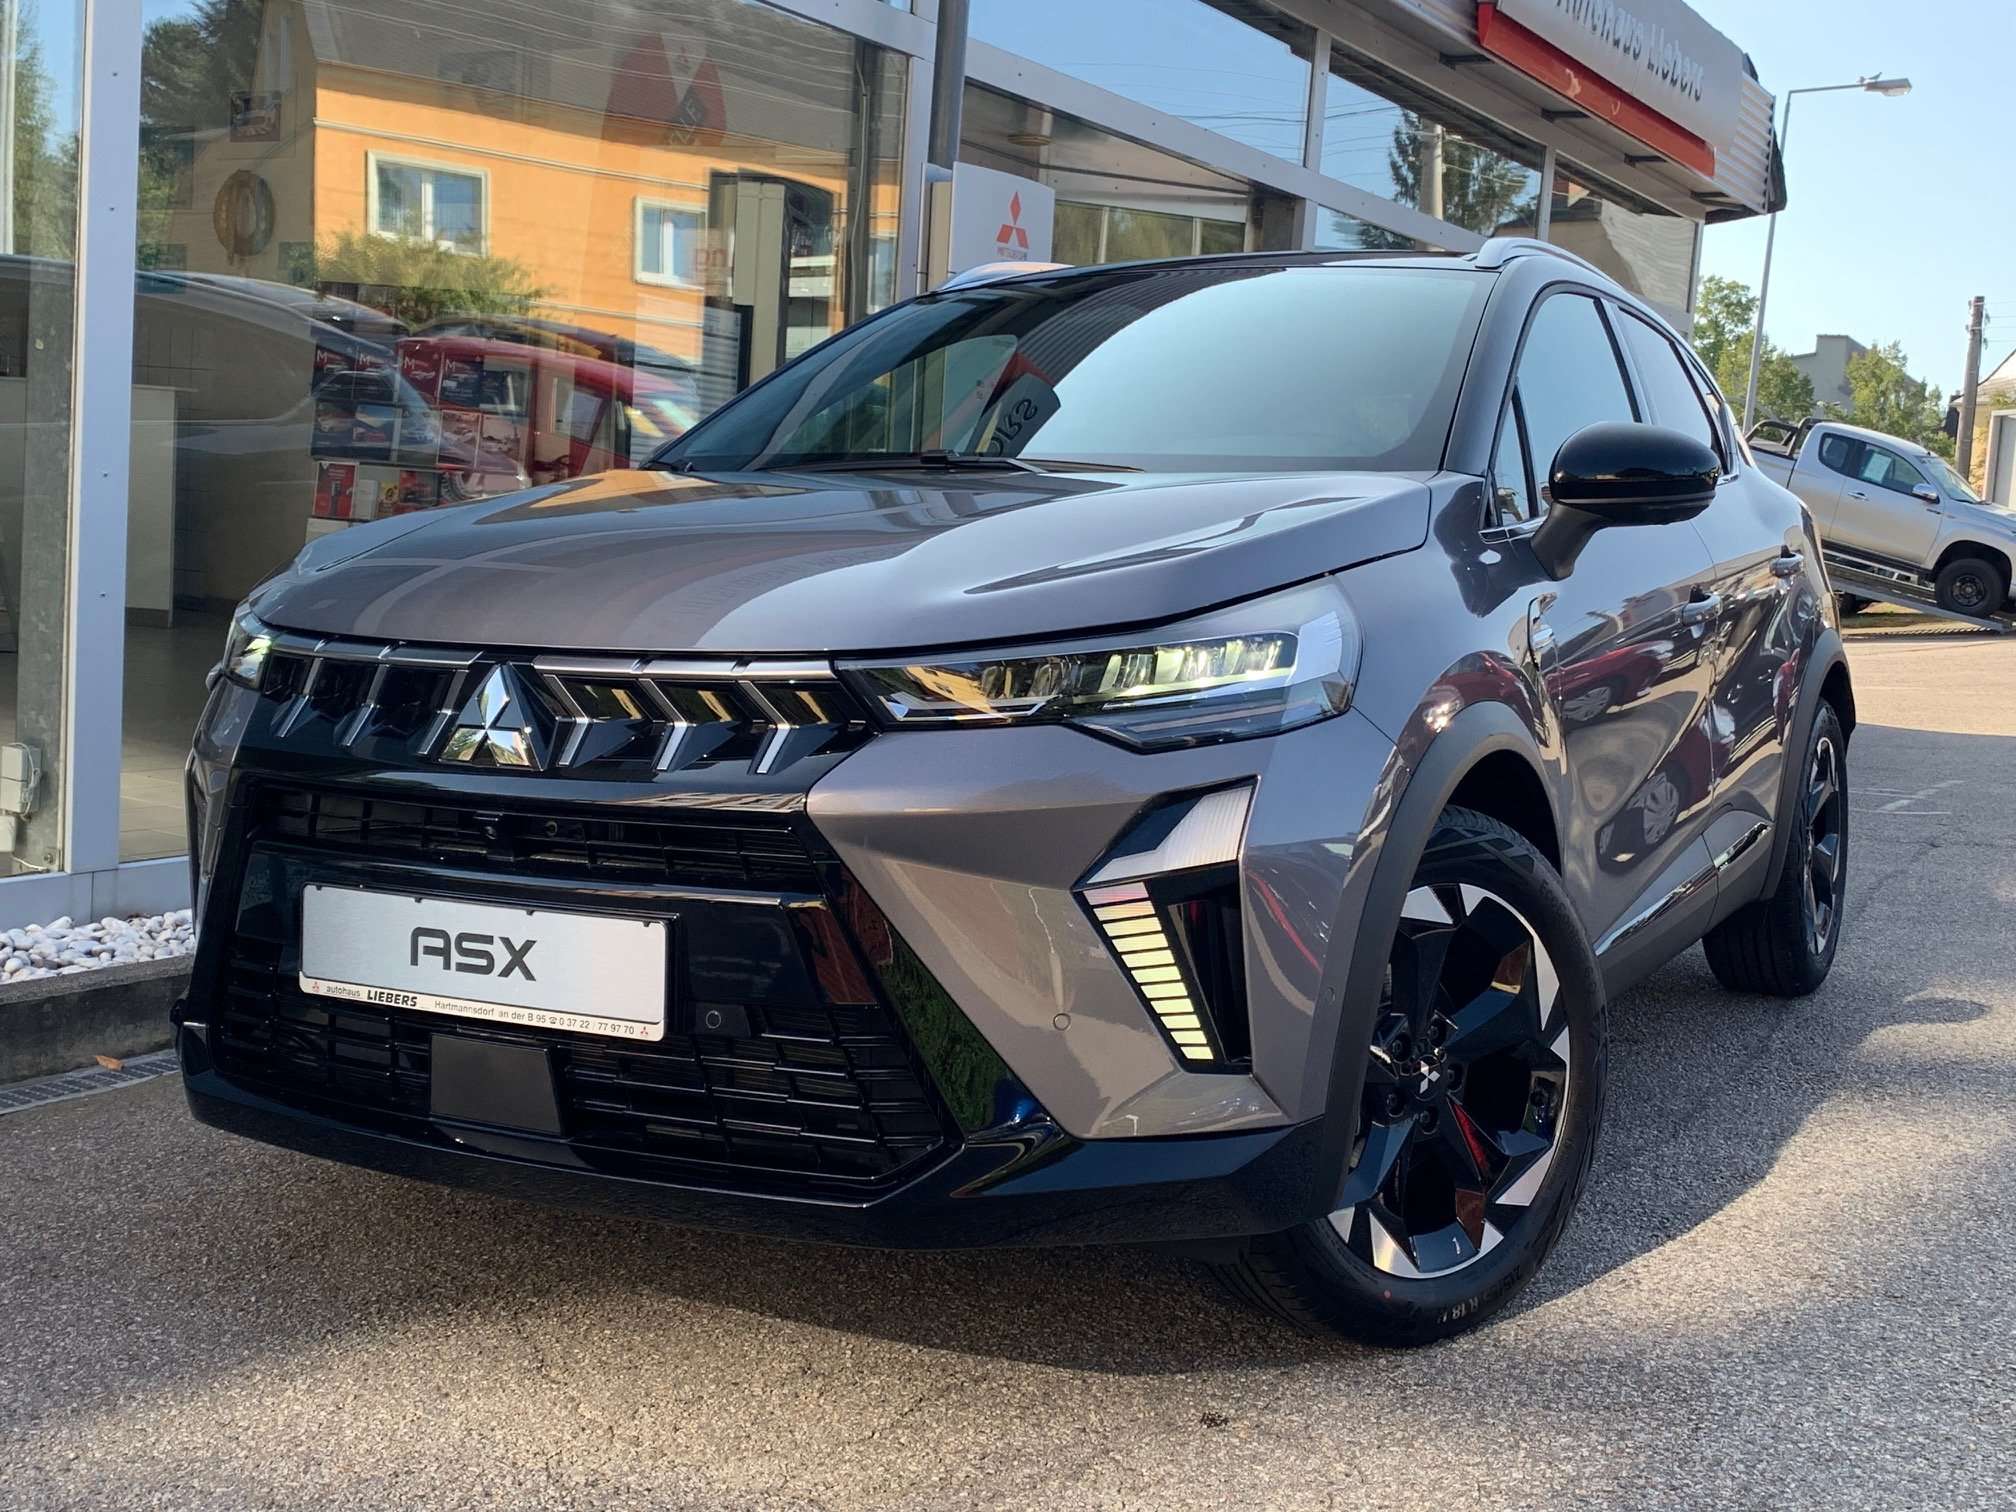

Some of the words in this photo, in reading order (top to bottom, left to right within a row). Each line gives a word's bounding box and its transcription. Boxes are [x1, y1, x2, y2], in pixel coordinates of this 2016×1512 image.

[410, 926, 537, 982] ASX
[326, 985, 361, 997] autohaus
[367, 989, 418, 1007] LIEBERS
[434, 1000, 494, 1016] Hartmannsdorf
[498, 1010, 509, 1018] an
[511, 1011, 526, 1020] der
[527, 1012, 534, 1022] B
[536, 1014, 547, 1023] 95
[559, 1017, 565, 1026] 0
[567, 1018, 578, 1028] 37
[580, 1020, 590, 1029] 22
[598, 1022, 609, 1032] 77
[611, 1024, 622, 1033] 97
[624, 1025, 635, 1035] 70
